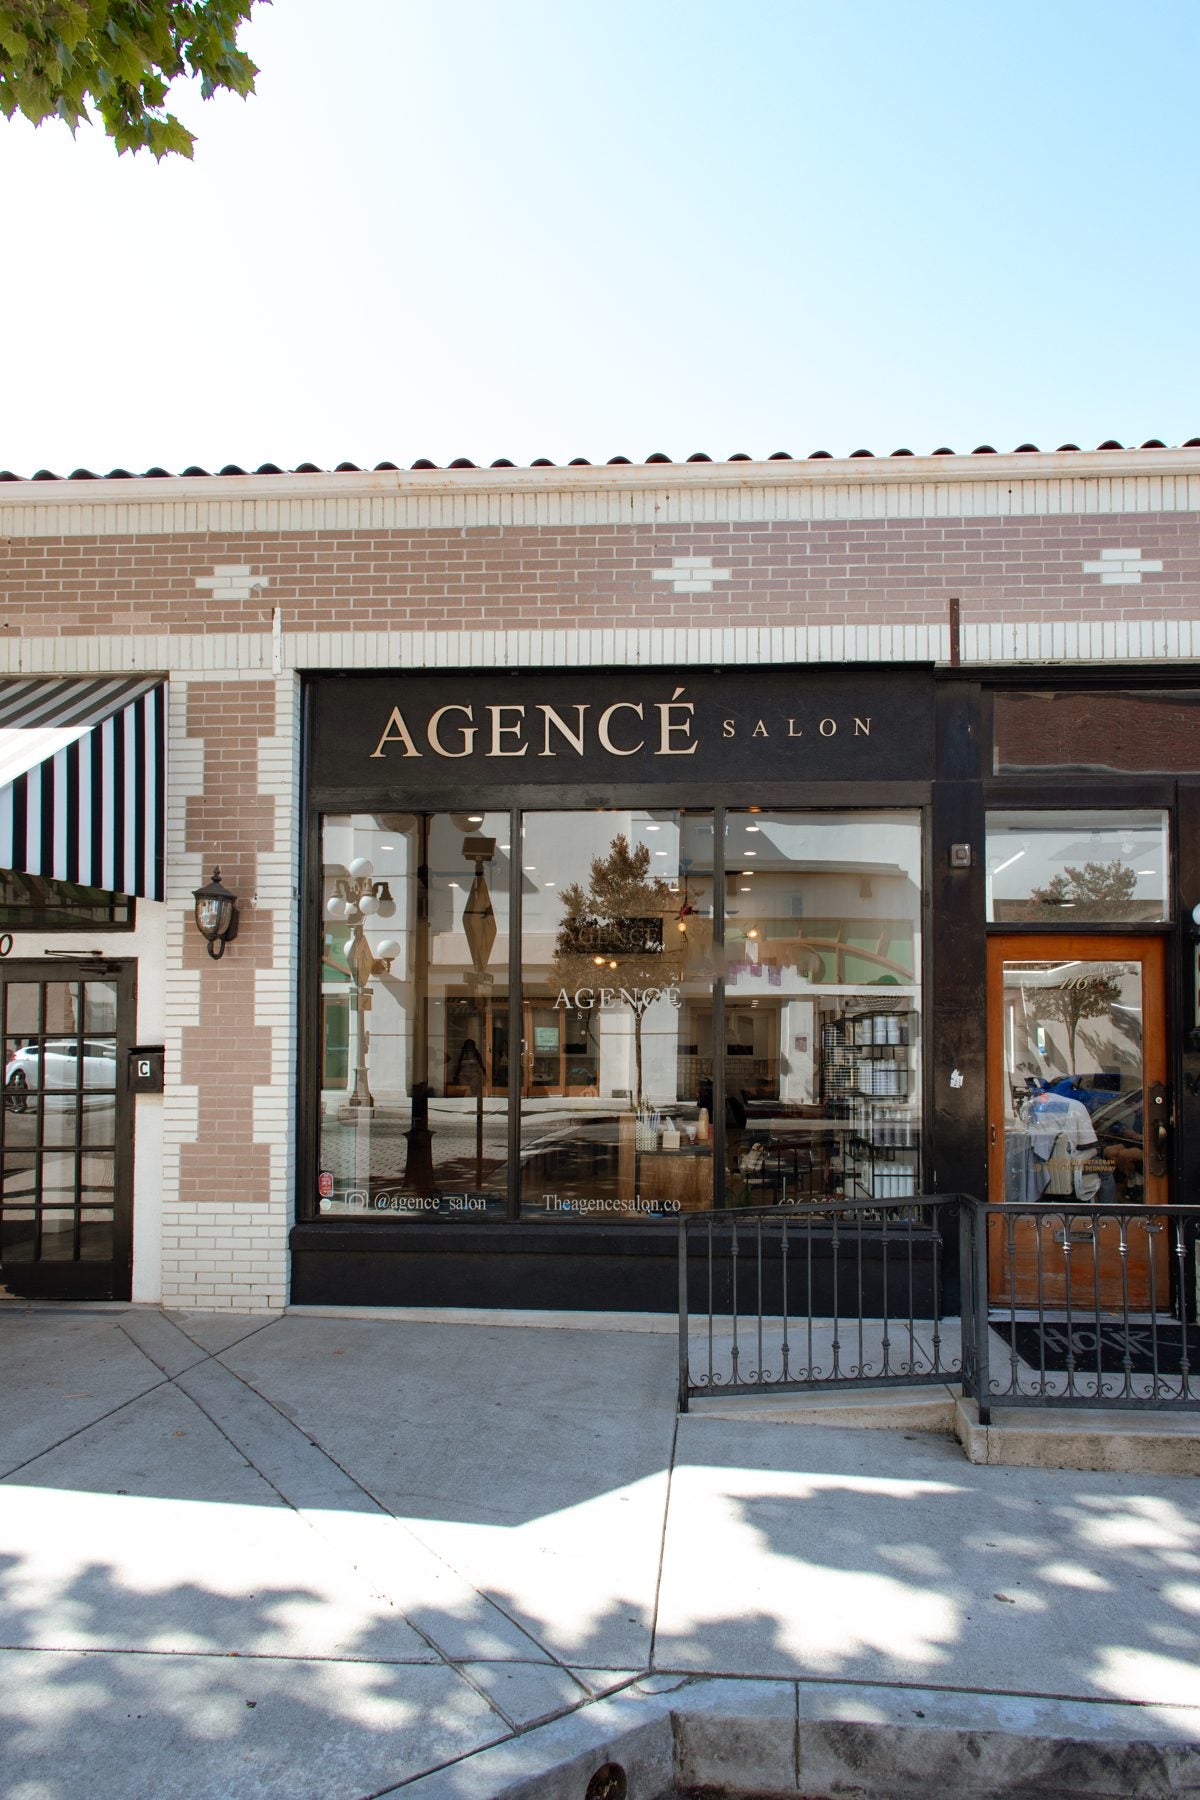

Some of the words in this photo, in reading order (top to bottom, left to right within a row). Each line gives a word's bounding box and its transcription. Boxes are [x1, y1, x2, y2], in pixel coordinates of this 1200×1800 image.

[370, 687, 699, 758] AGENCÉ
[722, 717, 873, 738] SALON
[139, 1062, 149, 1075] C
[374, 1192, 487, 1214] @agence_salon
[542, 1193, 682, 1215] Theagencesalon.co
